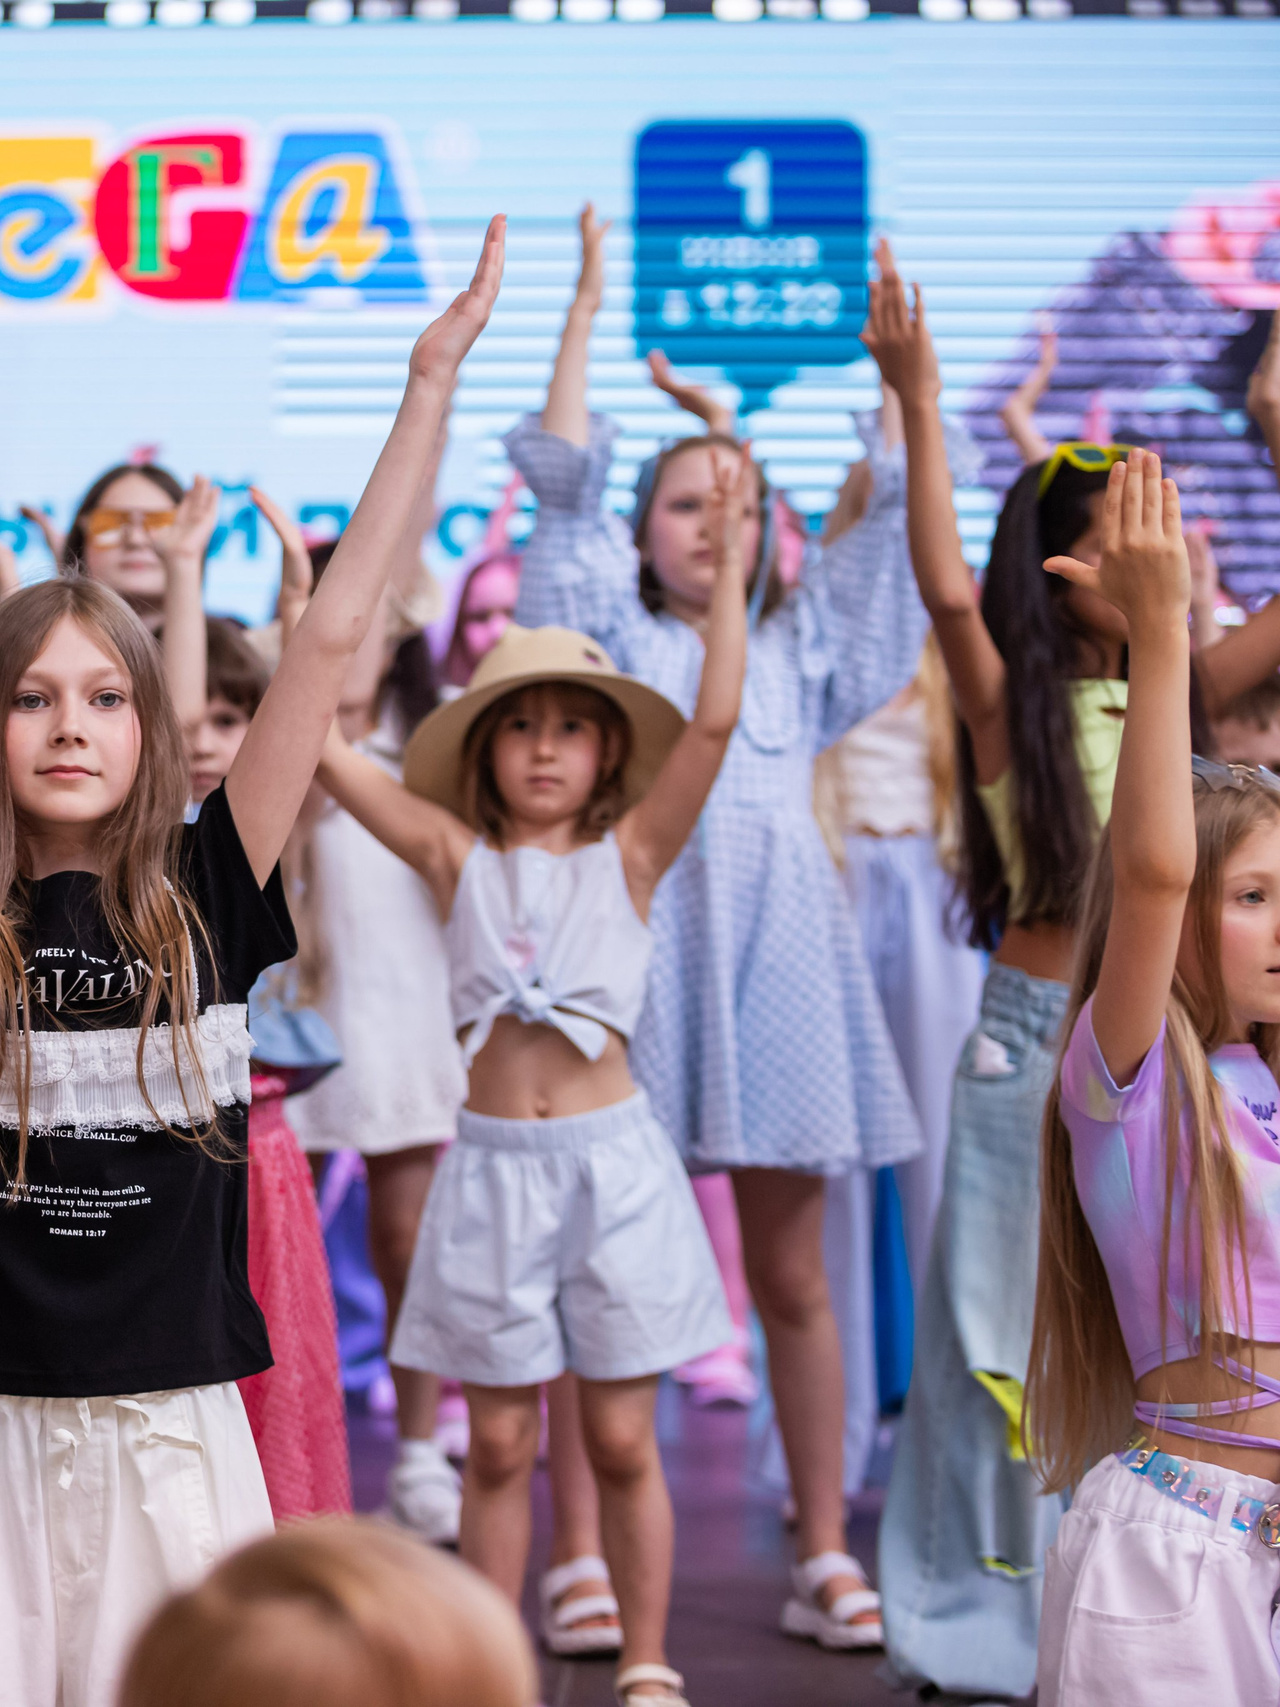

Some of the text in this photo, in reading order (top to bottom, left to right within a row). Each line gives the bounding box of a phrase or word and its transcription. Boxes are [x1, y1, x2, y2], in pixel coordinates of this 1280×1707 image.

[725, 147, 772, 229] 1
[35, 947, 76, 958] FREELY
[30, 1184, 43, 1193] pay
[44, 1184, 63, 1194] back
[65, 1186, 80, 1195] evil
[82, 1187, 100, 1196] with
[0, 1190, 22, 1203] things
[23, 1193, 32, 1202] in
[33, 1196, 51, 1205] such
[59, 1199, 75, 1208] way
[95, 1200, 128, 1210] everyone
[128, 1198, 141, 1206] can
[141, 1196, 152, 1205] see
[41, 1209, 56, 1217] you
[71, 1208, 112, 1218] honorable.
[49, 1227, 107, 1237] ROMANS 12:17
